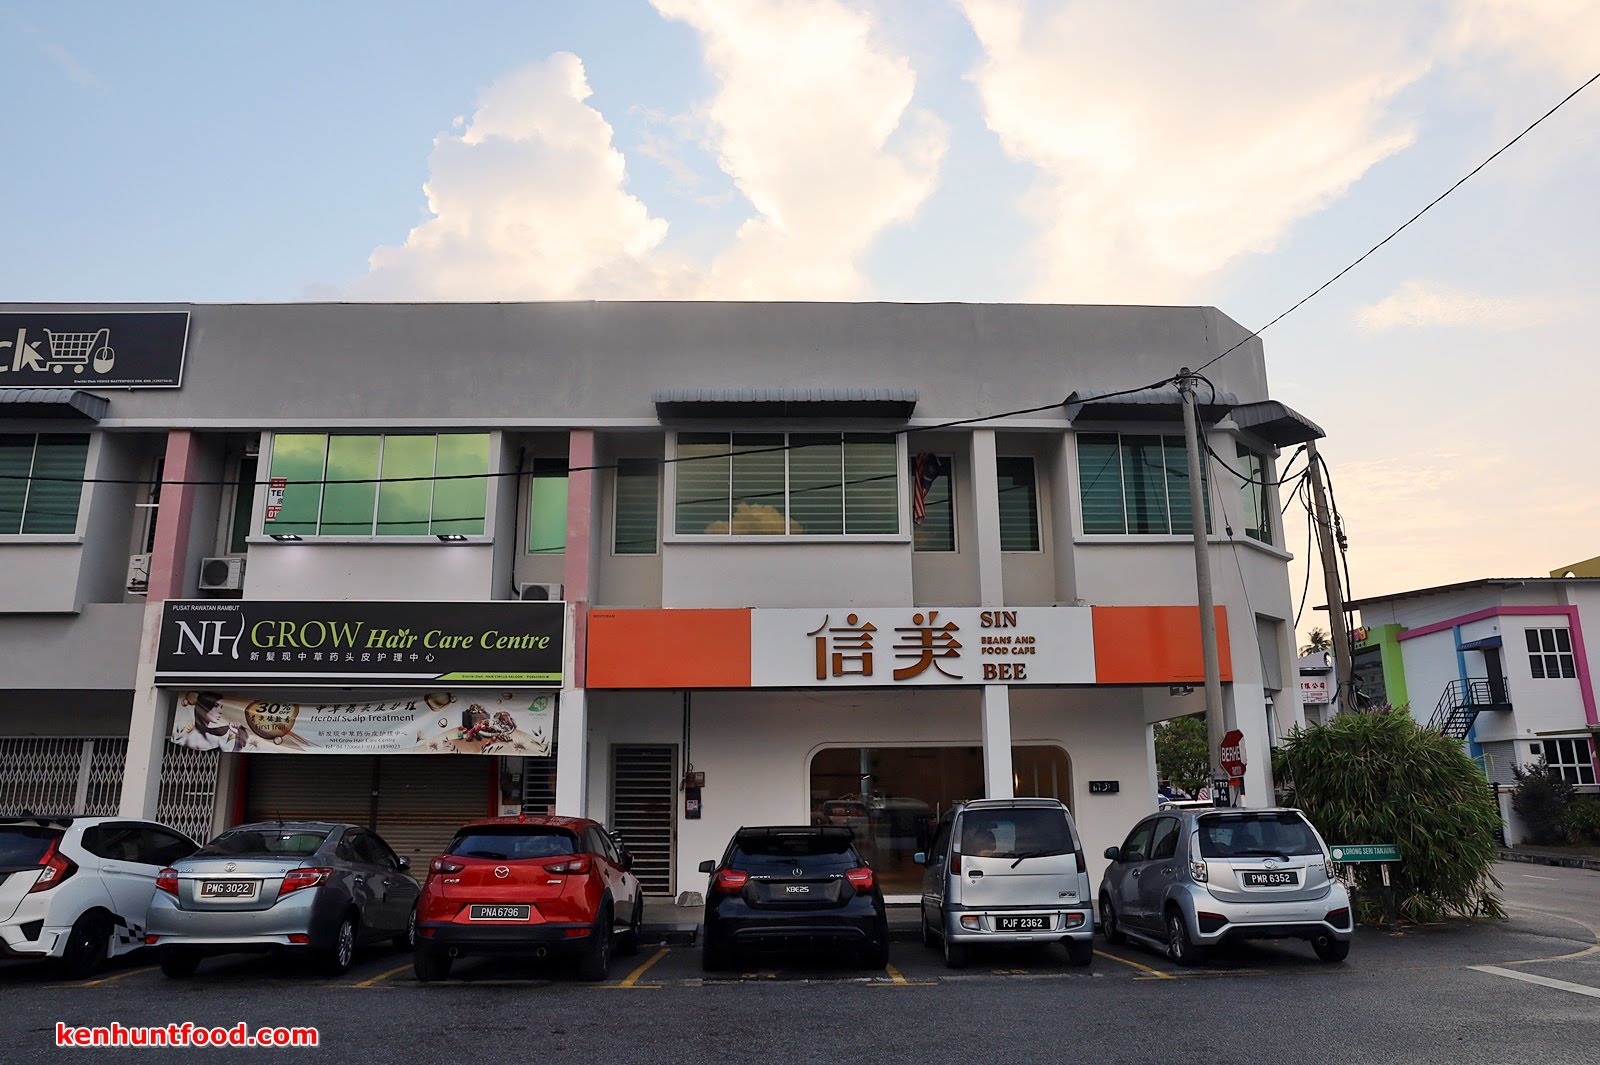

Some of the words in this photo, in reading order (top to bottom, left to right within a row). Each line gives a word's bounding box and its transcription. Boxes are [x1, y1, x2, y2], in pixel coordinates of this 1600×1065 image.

[980, 611, 1017, 628] SIN
[173, 612, 245, 660] NH
[251, 620, 364, 649] GROW
[364, 628, 418, 649] Hair
[423, 629, 474, 649] Care
[480, 629, 551, 650] Centre
[981, 636, 1012, 645] BEANS
[1015, 636, 1036, 644] AND
[807, 610, 963, 681] 信美
[981, 646, 1009, 655] FOOD
[1011, 646, 1036, 655] CAFE
[982, 663, 1027, 680] BEE
[342, 714, 366, 723] Scalp
[368, 714, 414, 722] Treatment
[1221, 746, 1241, 762] BERHE
[1251, 874, 1268, 883] PMR
[1269, 873, 1291, 883] 6352
[206, 883, 223, 893] PMG
[225, 883, 250, 893] 3022
[480, 907, 519, 917] PNA6796
[1003, 919, 1018, 928] PJF
[1020, 918, 1043, 928] 2362
